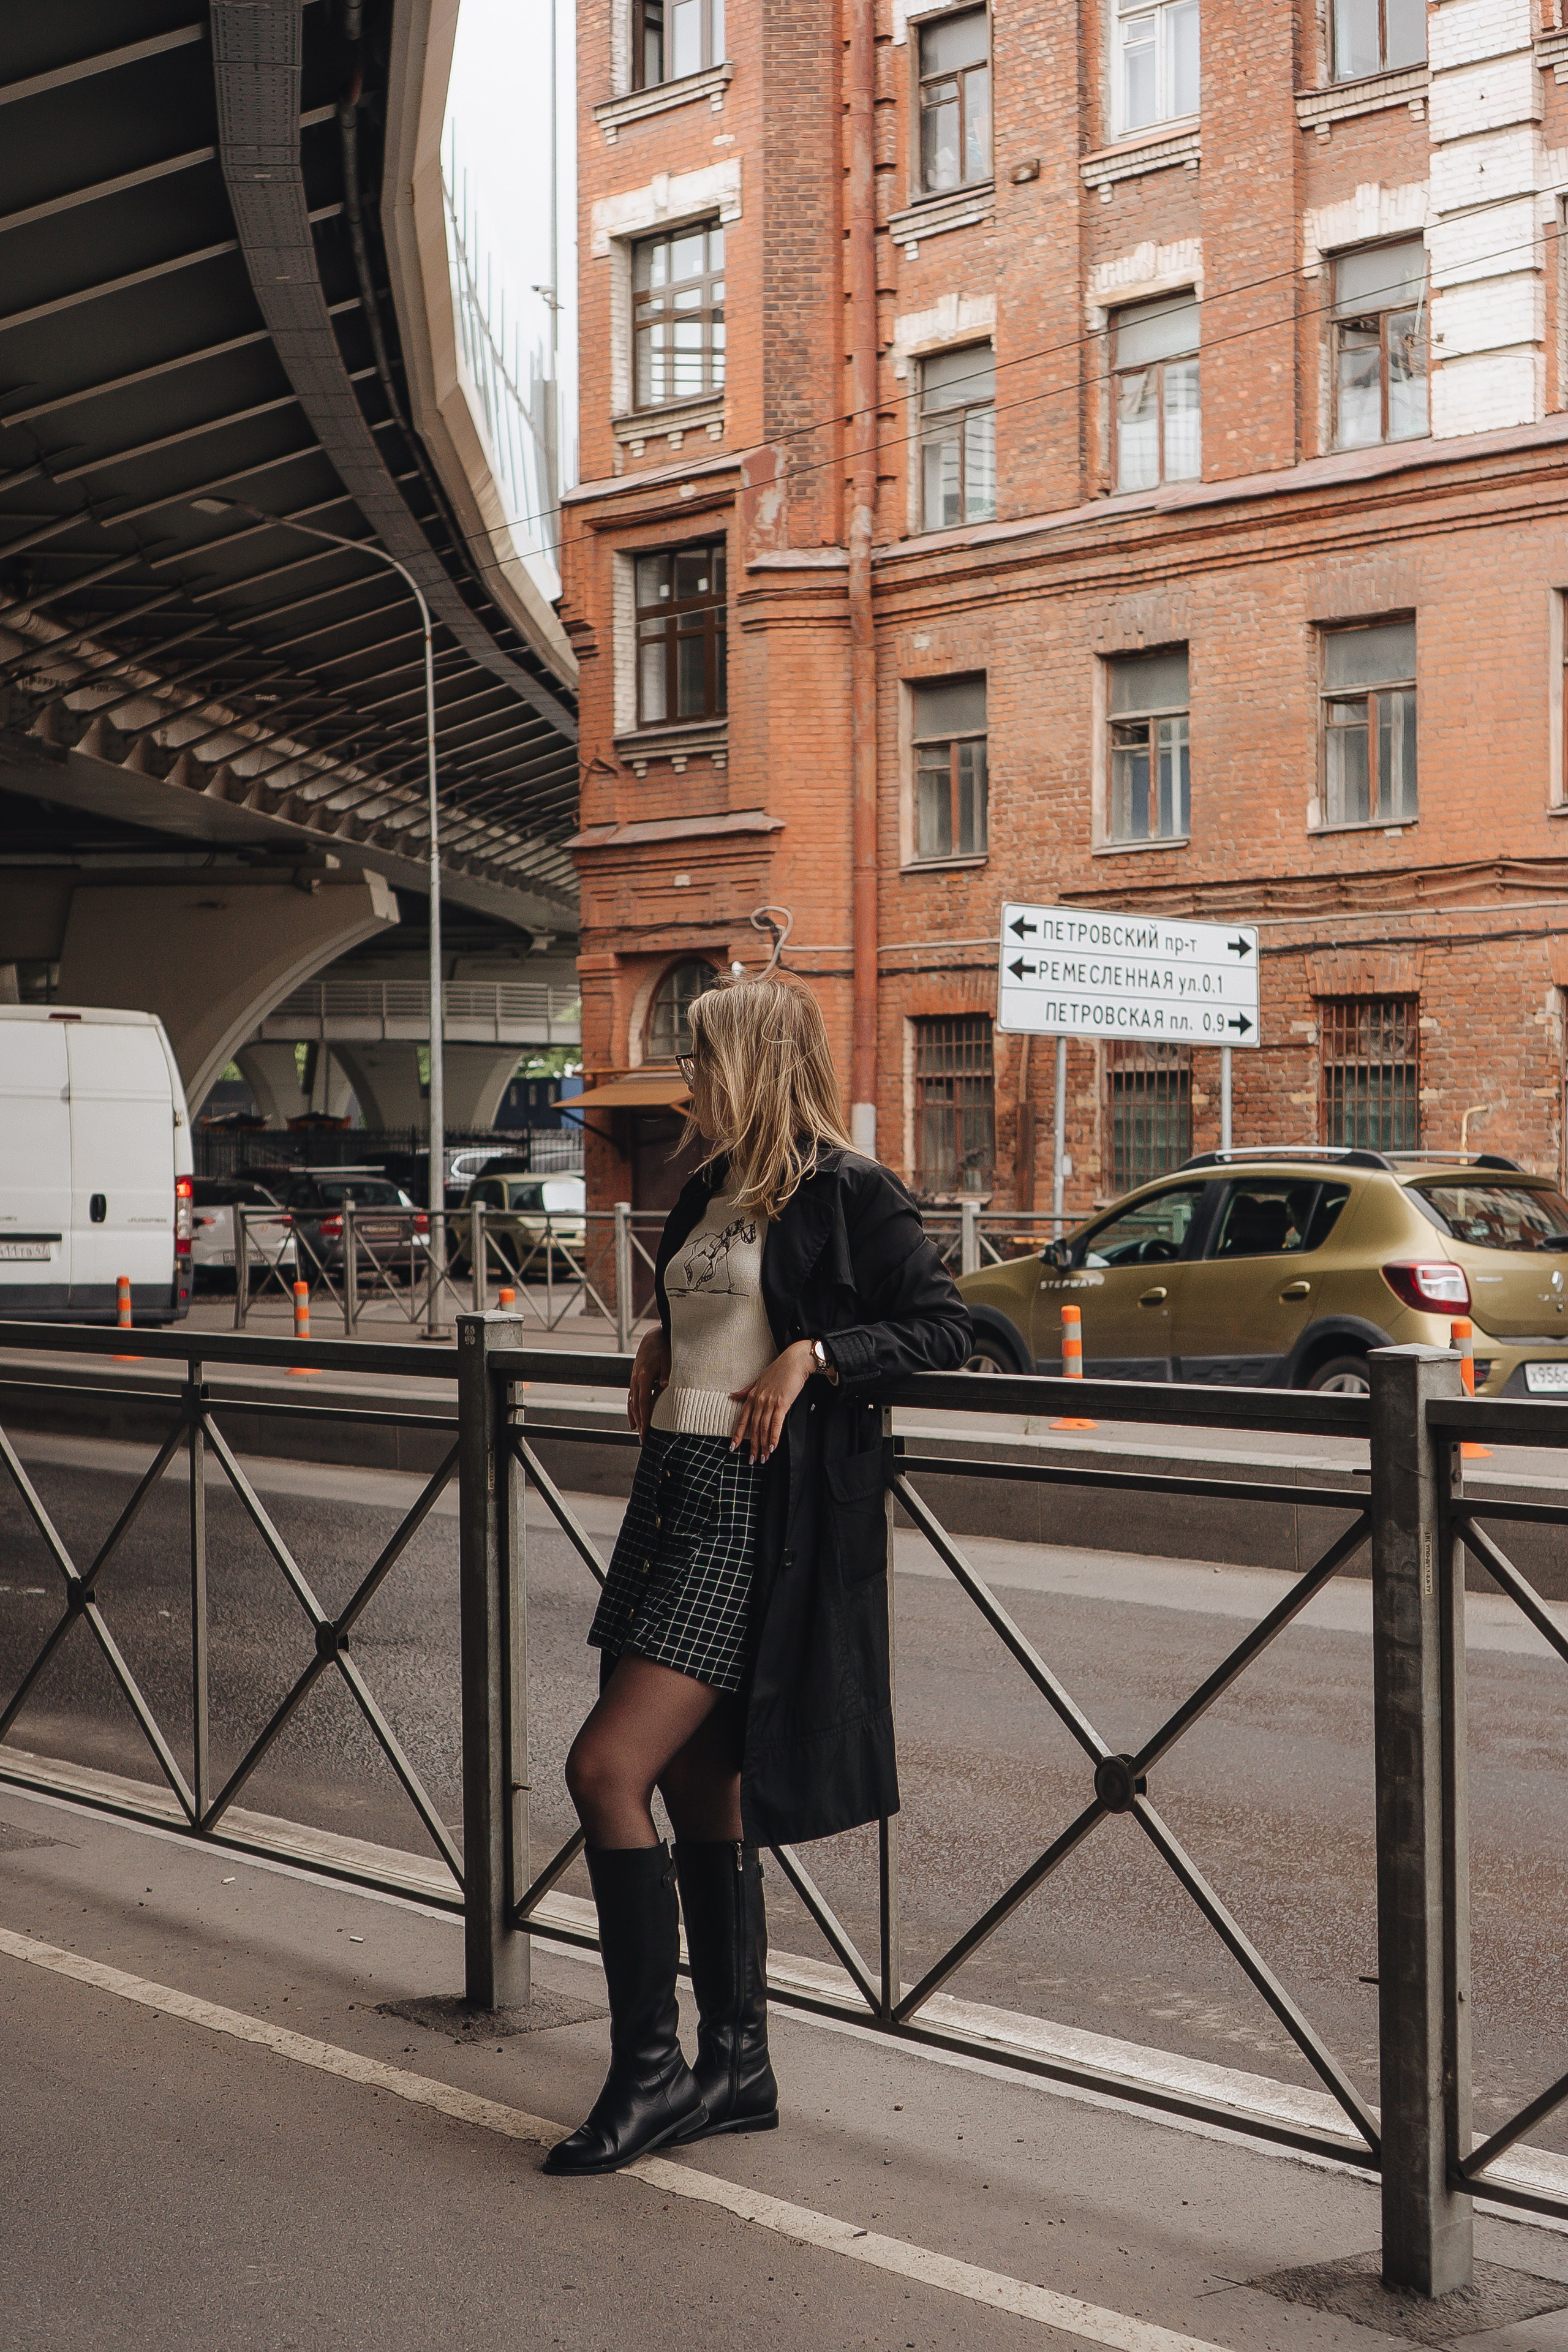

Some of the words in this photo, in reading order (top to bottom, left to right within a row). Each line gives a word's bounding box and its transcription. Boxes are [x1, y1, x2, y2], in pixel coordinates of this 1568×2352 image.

[1044, 920, 1159, 949] ПЕТРОВСКИЙ
[1166, 937, 1197, 956] пр-т
[1039, 960, 1173, 990] РЕМЕСЛЕННАЯ
[1046, 1001, 1164, 1028] ПЕТРОВСКАЯ
[1170, 1016, 1193, 1031] пл.
[1203, 1012, 1224, 1033] 0,9
